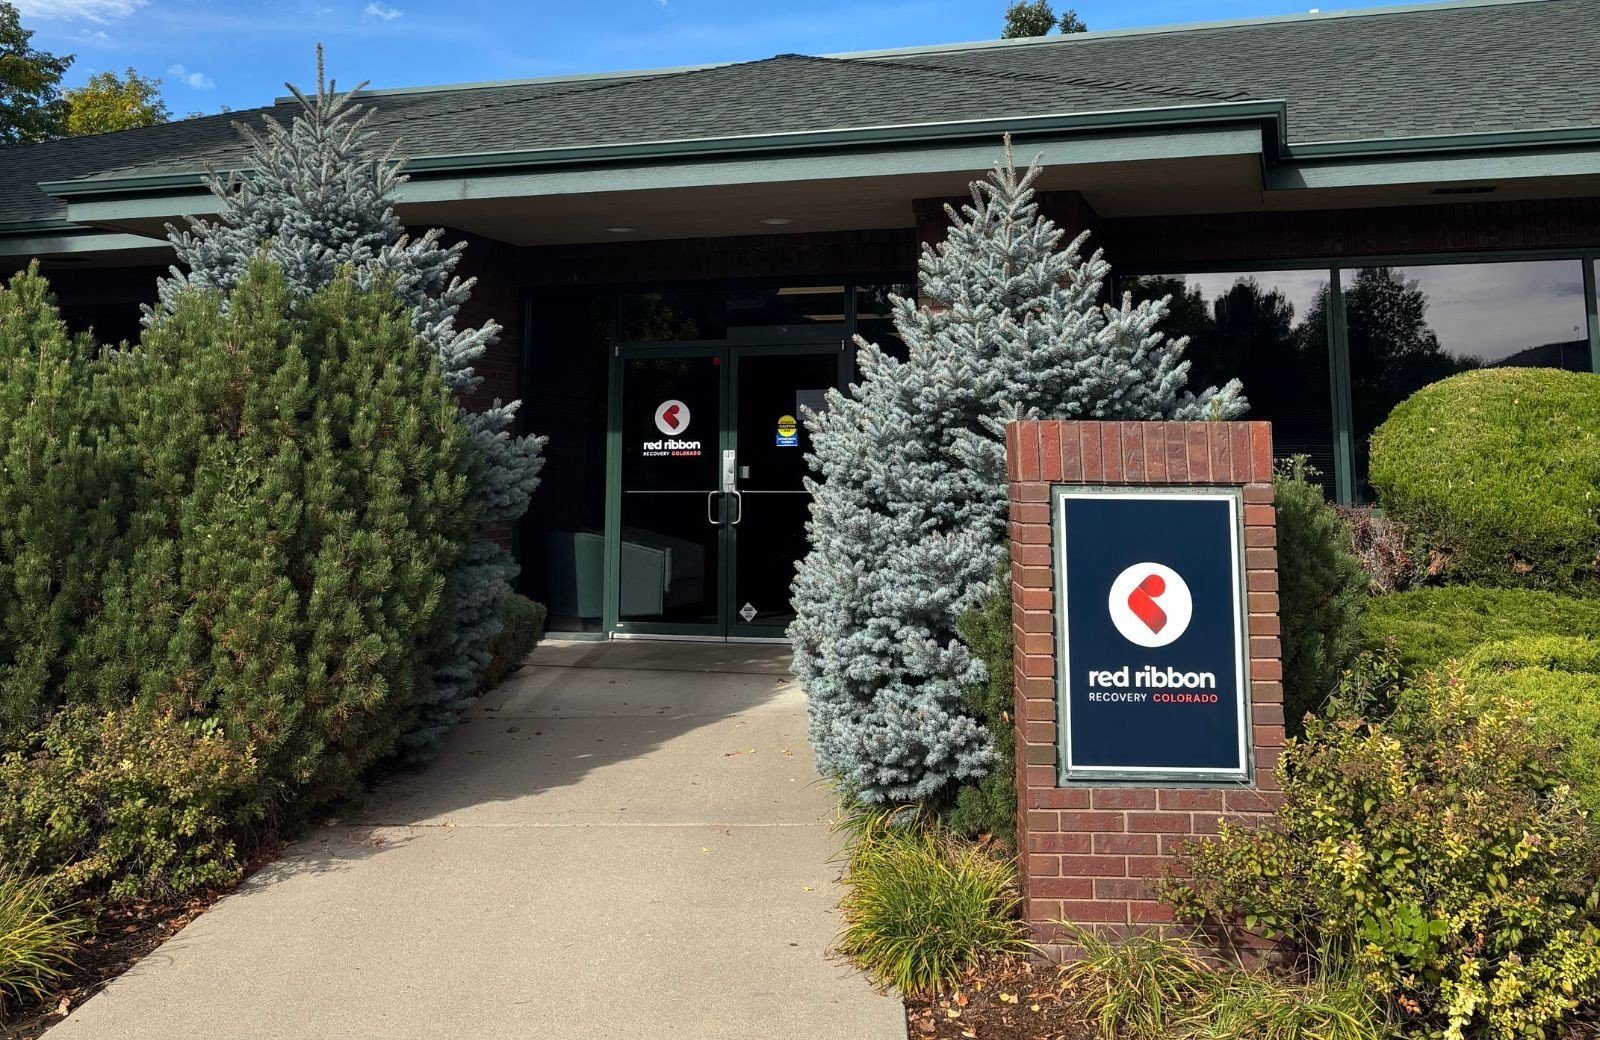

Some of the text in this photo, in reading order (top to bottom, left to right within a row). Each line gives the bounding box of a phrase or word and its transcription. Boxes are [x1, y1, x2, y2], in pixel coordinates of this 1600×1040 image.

[643, 438, 701, 450] red ribbon
[1088, 665, 1216, 689] red ribbon
[1088, 692, 1218, 703] RECOVERY COLORADO
